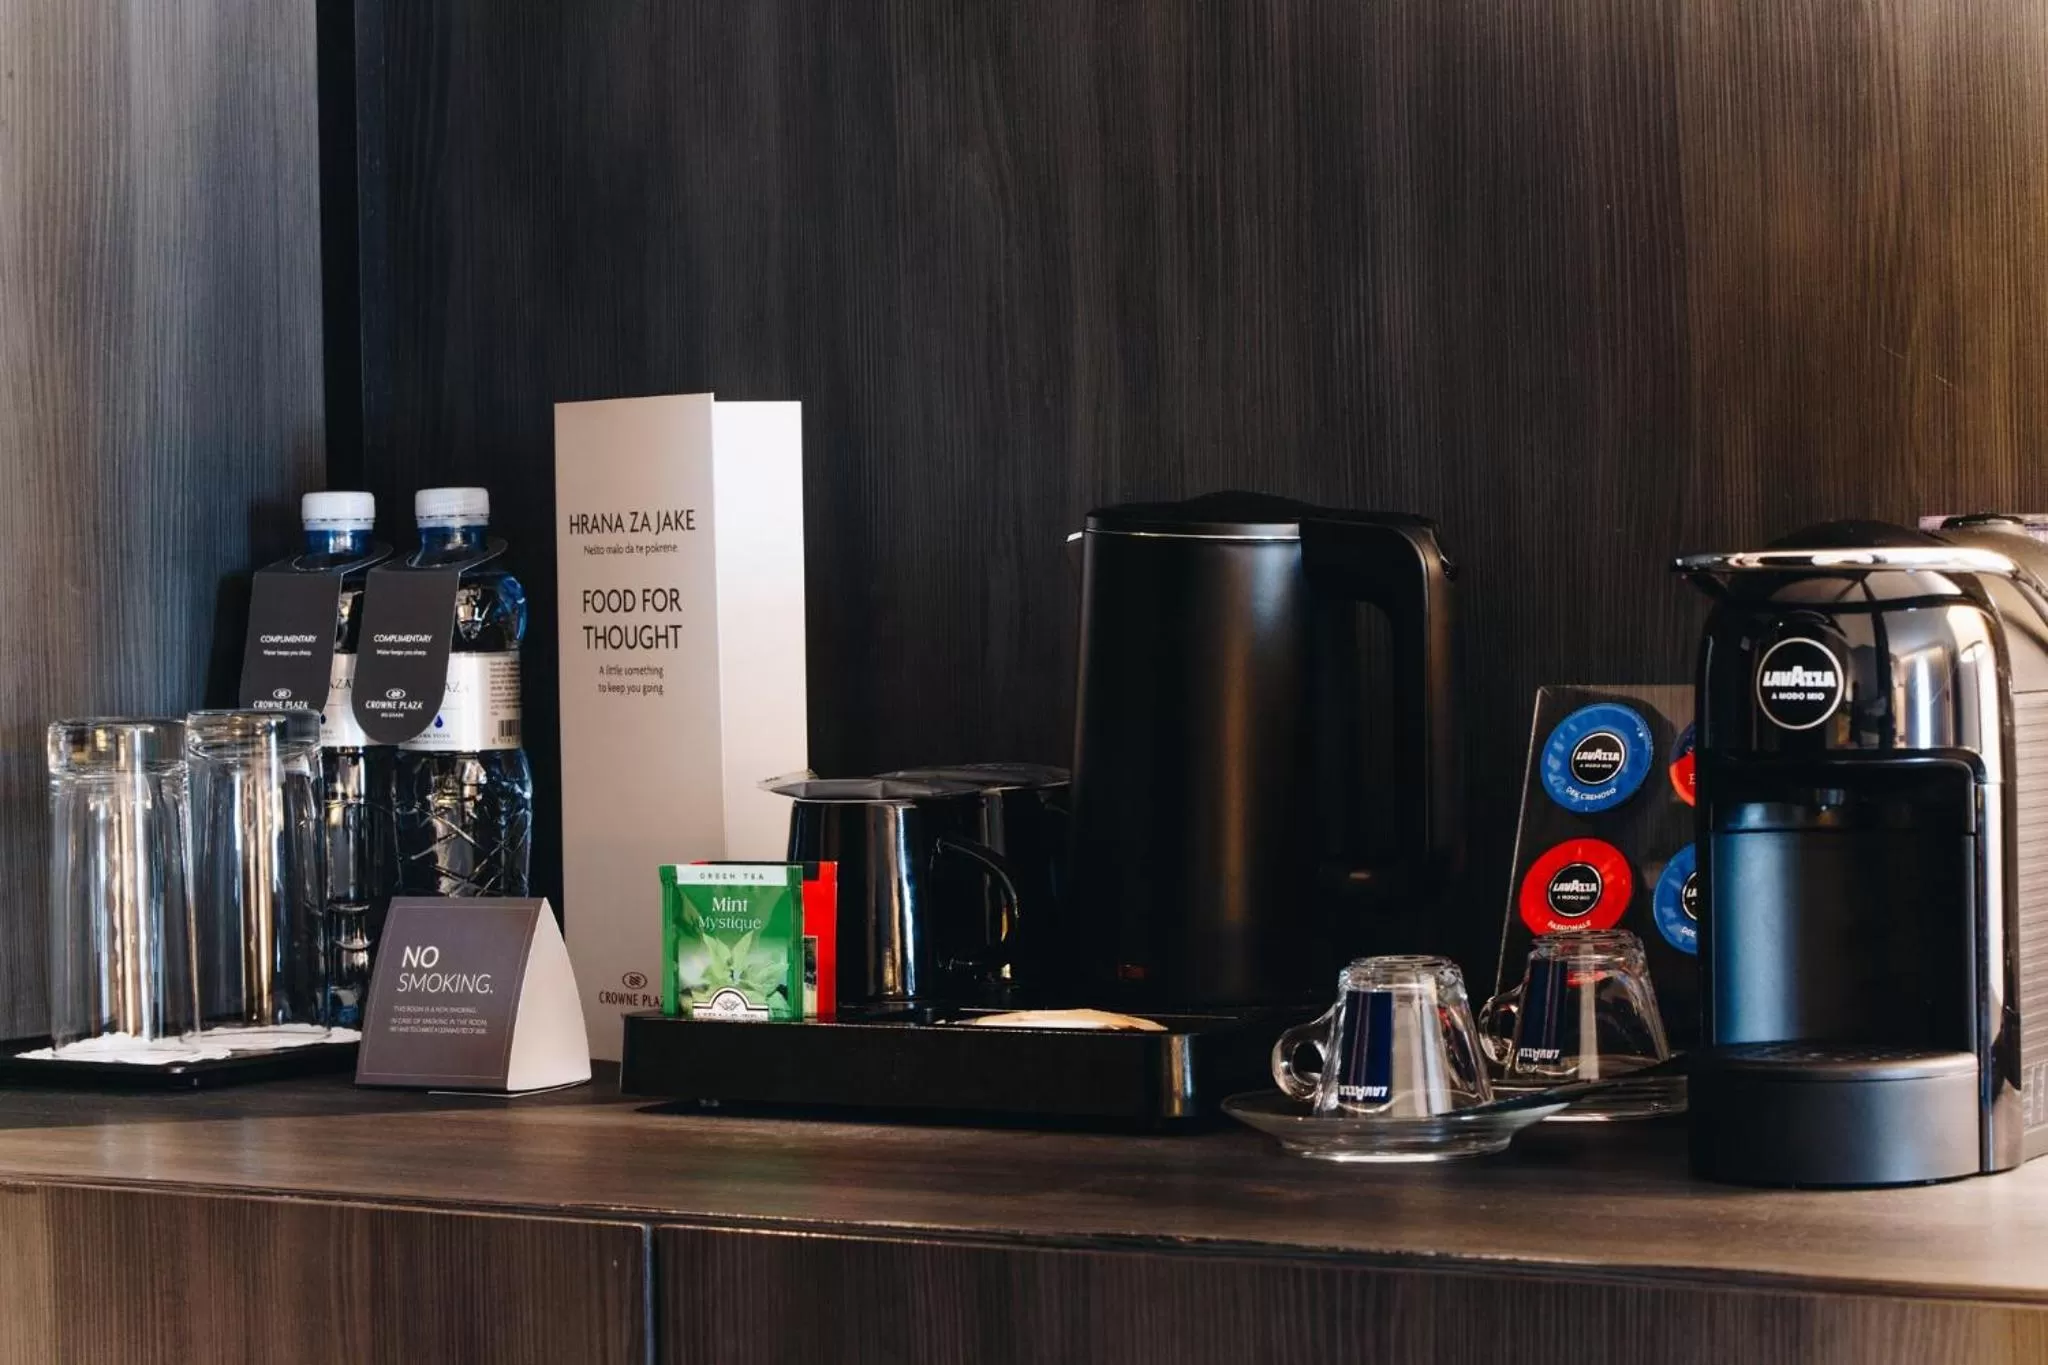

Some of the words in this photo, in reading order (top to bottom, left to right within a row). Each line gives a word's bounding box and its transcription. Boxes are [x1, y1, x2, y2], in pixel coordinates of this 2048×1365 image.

[569, 513, 625, 535] HRANA
[629, 511, 652, 533] ZA
[654, 508, 697, 535] JAKE
[582, 588, 636, 614] FOOD
[642, 588, 683, 613] FOR
[260, 634, 317, 643] COMPLIMENTARY
[373, 634, 432, 643] COMPLIMENTARY
[582, 625, 683, 650] THOUGHT
[599, 665, 605, 675] A
[624, 664, 665, 679] something
[1762, 665, 1837, 688] LAVAZZA
[626, 684, 641, 696] you
[1771, 692, 1777, 700] A
[1779, 692, 1805, 700] MODO
[1807, 692, 1825, 701] MIO
[253, 700, 283, 710] CROWNE
[285, 700, 309, 710] PLAZA
[365, 700, 397, 710] CROWNE
[399, 700, 424, 710] PLAZA
[1575, 748, 1620, 761] LAVAZZA
[699, 872, 736, 880] GREEN
[743, 872, 764, 880] TEA
[1552, 879, 1597, 892] LAVAZZA
[711, 896, 749, 912] Mint
[698, 915, 762, 932] Mystique
[402, 945, 440, 968] NO
[397, 972, 494, 994] SMOKING.
[598, 991, 639, 1006] CROWNE
